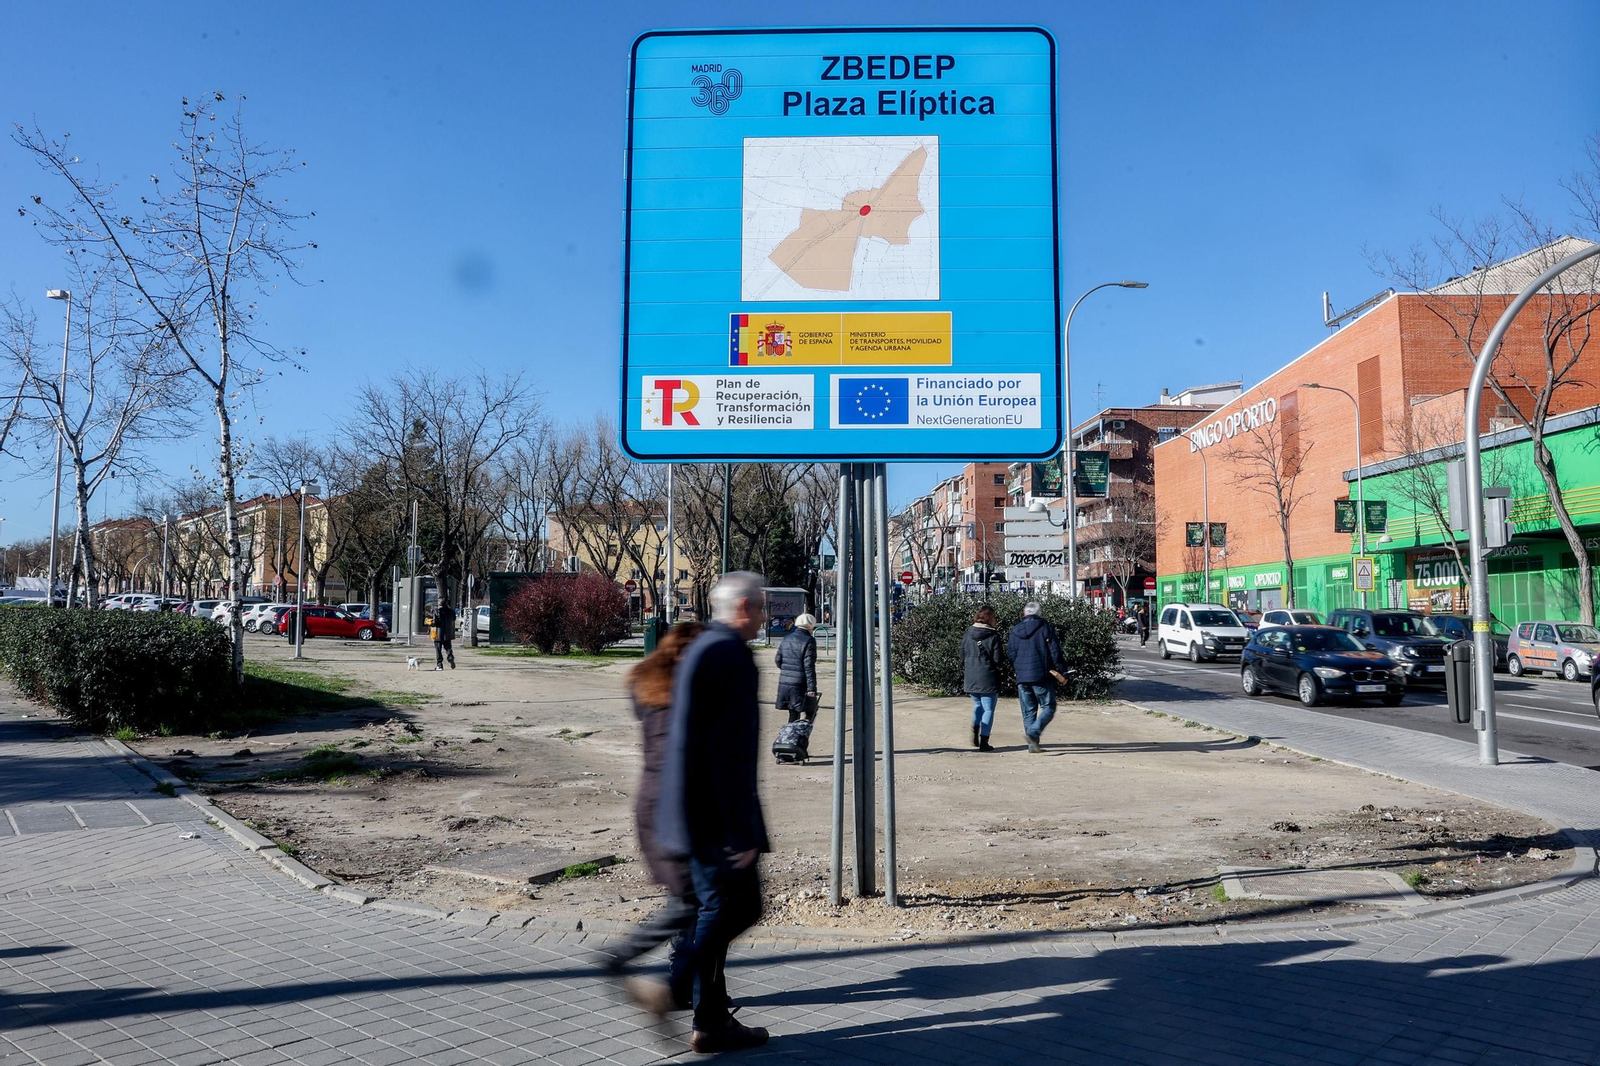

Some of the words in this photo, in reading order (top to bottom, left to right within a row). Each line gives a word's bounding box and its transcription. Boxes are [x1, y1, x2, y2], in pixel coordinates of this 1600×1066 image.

[691, 64, 722, 73] MADRID
[821, 54, 956, 81] ZBEDEP
[691, 68, 743, 115] 360
[783, 91, 866, 117] Plaza
[878, 89, 996, 122] Elíptica
[808, 337, 833, 345] ESPAÑA
[716, 379, 742, 389] Plan
[745, 379, 761, 389] de
[916, 377, 994, 389] Financiado
[998, 379, 1022, 392] por
[715, 390, 802, 402] Recuperación,
[916, 394, 928, 406] la
[932, 394, 974, 407] Unión
[978, 394, 1037, 409] Europea
[716, 402, 811, 413] Transformación
[717, 416, 724, 426] y
[728, 415, 793, 425] Resiliencia
[916, 414, 1023, 425] NextGenerationEU
[1190, 420, 1223, 453] BINGO
[1225, 397, 1276, 439] OPORTO
[1492, 545, 1529, 558] JACKPOTS
[1253, 572, 1282, 587] OPORTO
[1415, 560, 1460, 587] 75.000
